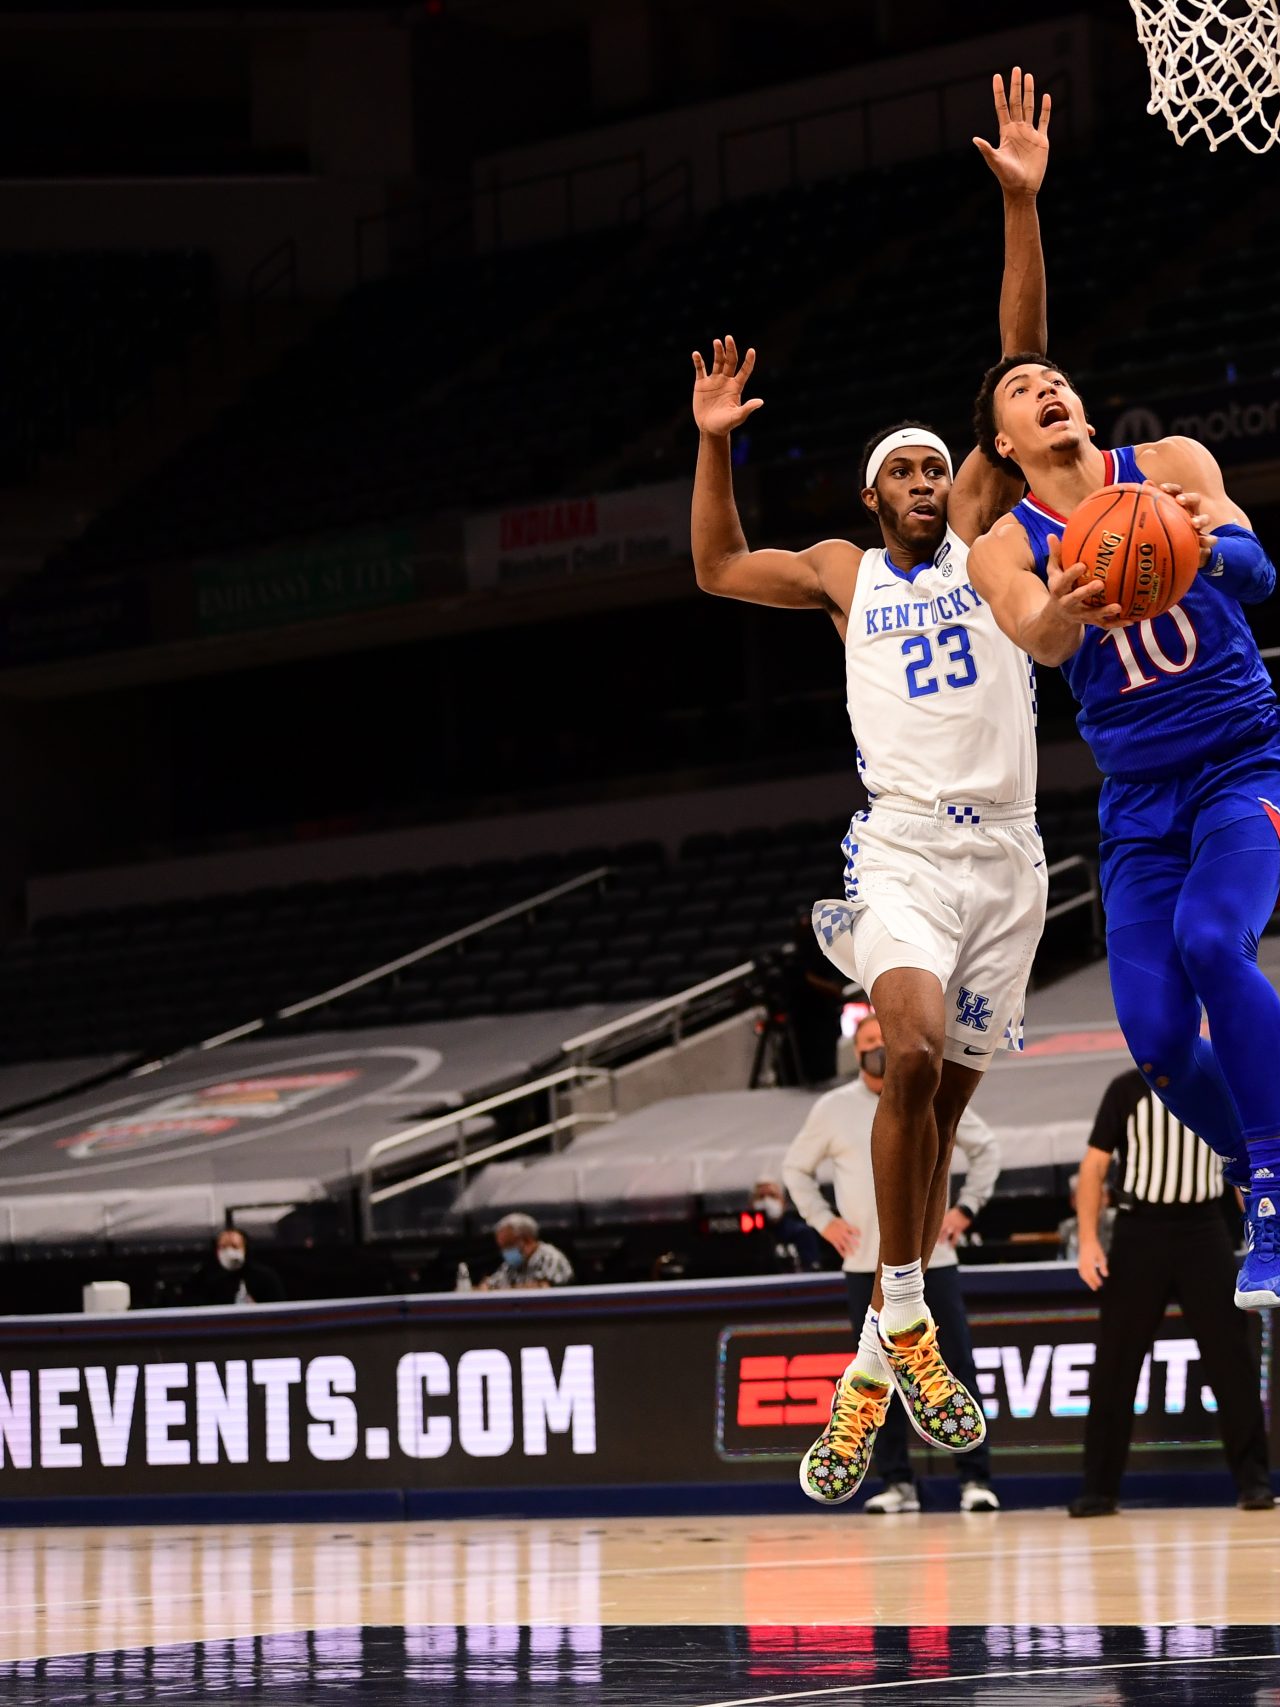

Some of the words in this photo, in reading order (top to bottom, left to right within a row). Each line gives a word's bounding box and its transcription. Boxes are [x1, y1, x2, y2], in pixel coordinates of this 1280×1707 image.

[500, 496, 599, 551] INDIANA
[866, 582, 982, 635] KENTUCKY
[1100, 603, 1198, 694] 10
[901, 625, 979, 699] 23
[0, 1344, 597, 1469] NEVENTS.COM
[737, 1353, 858, 1428] ES
[971, 1338, 1219, 1420] EVET
